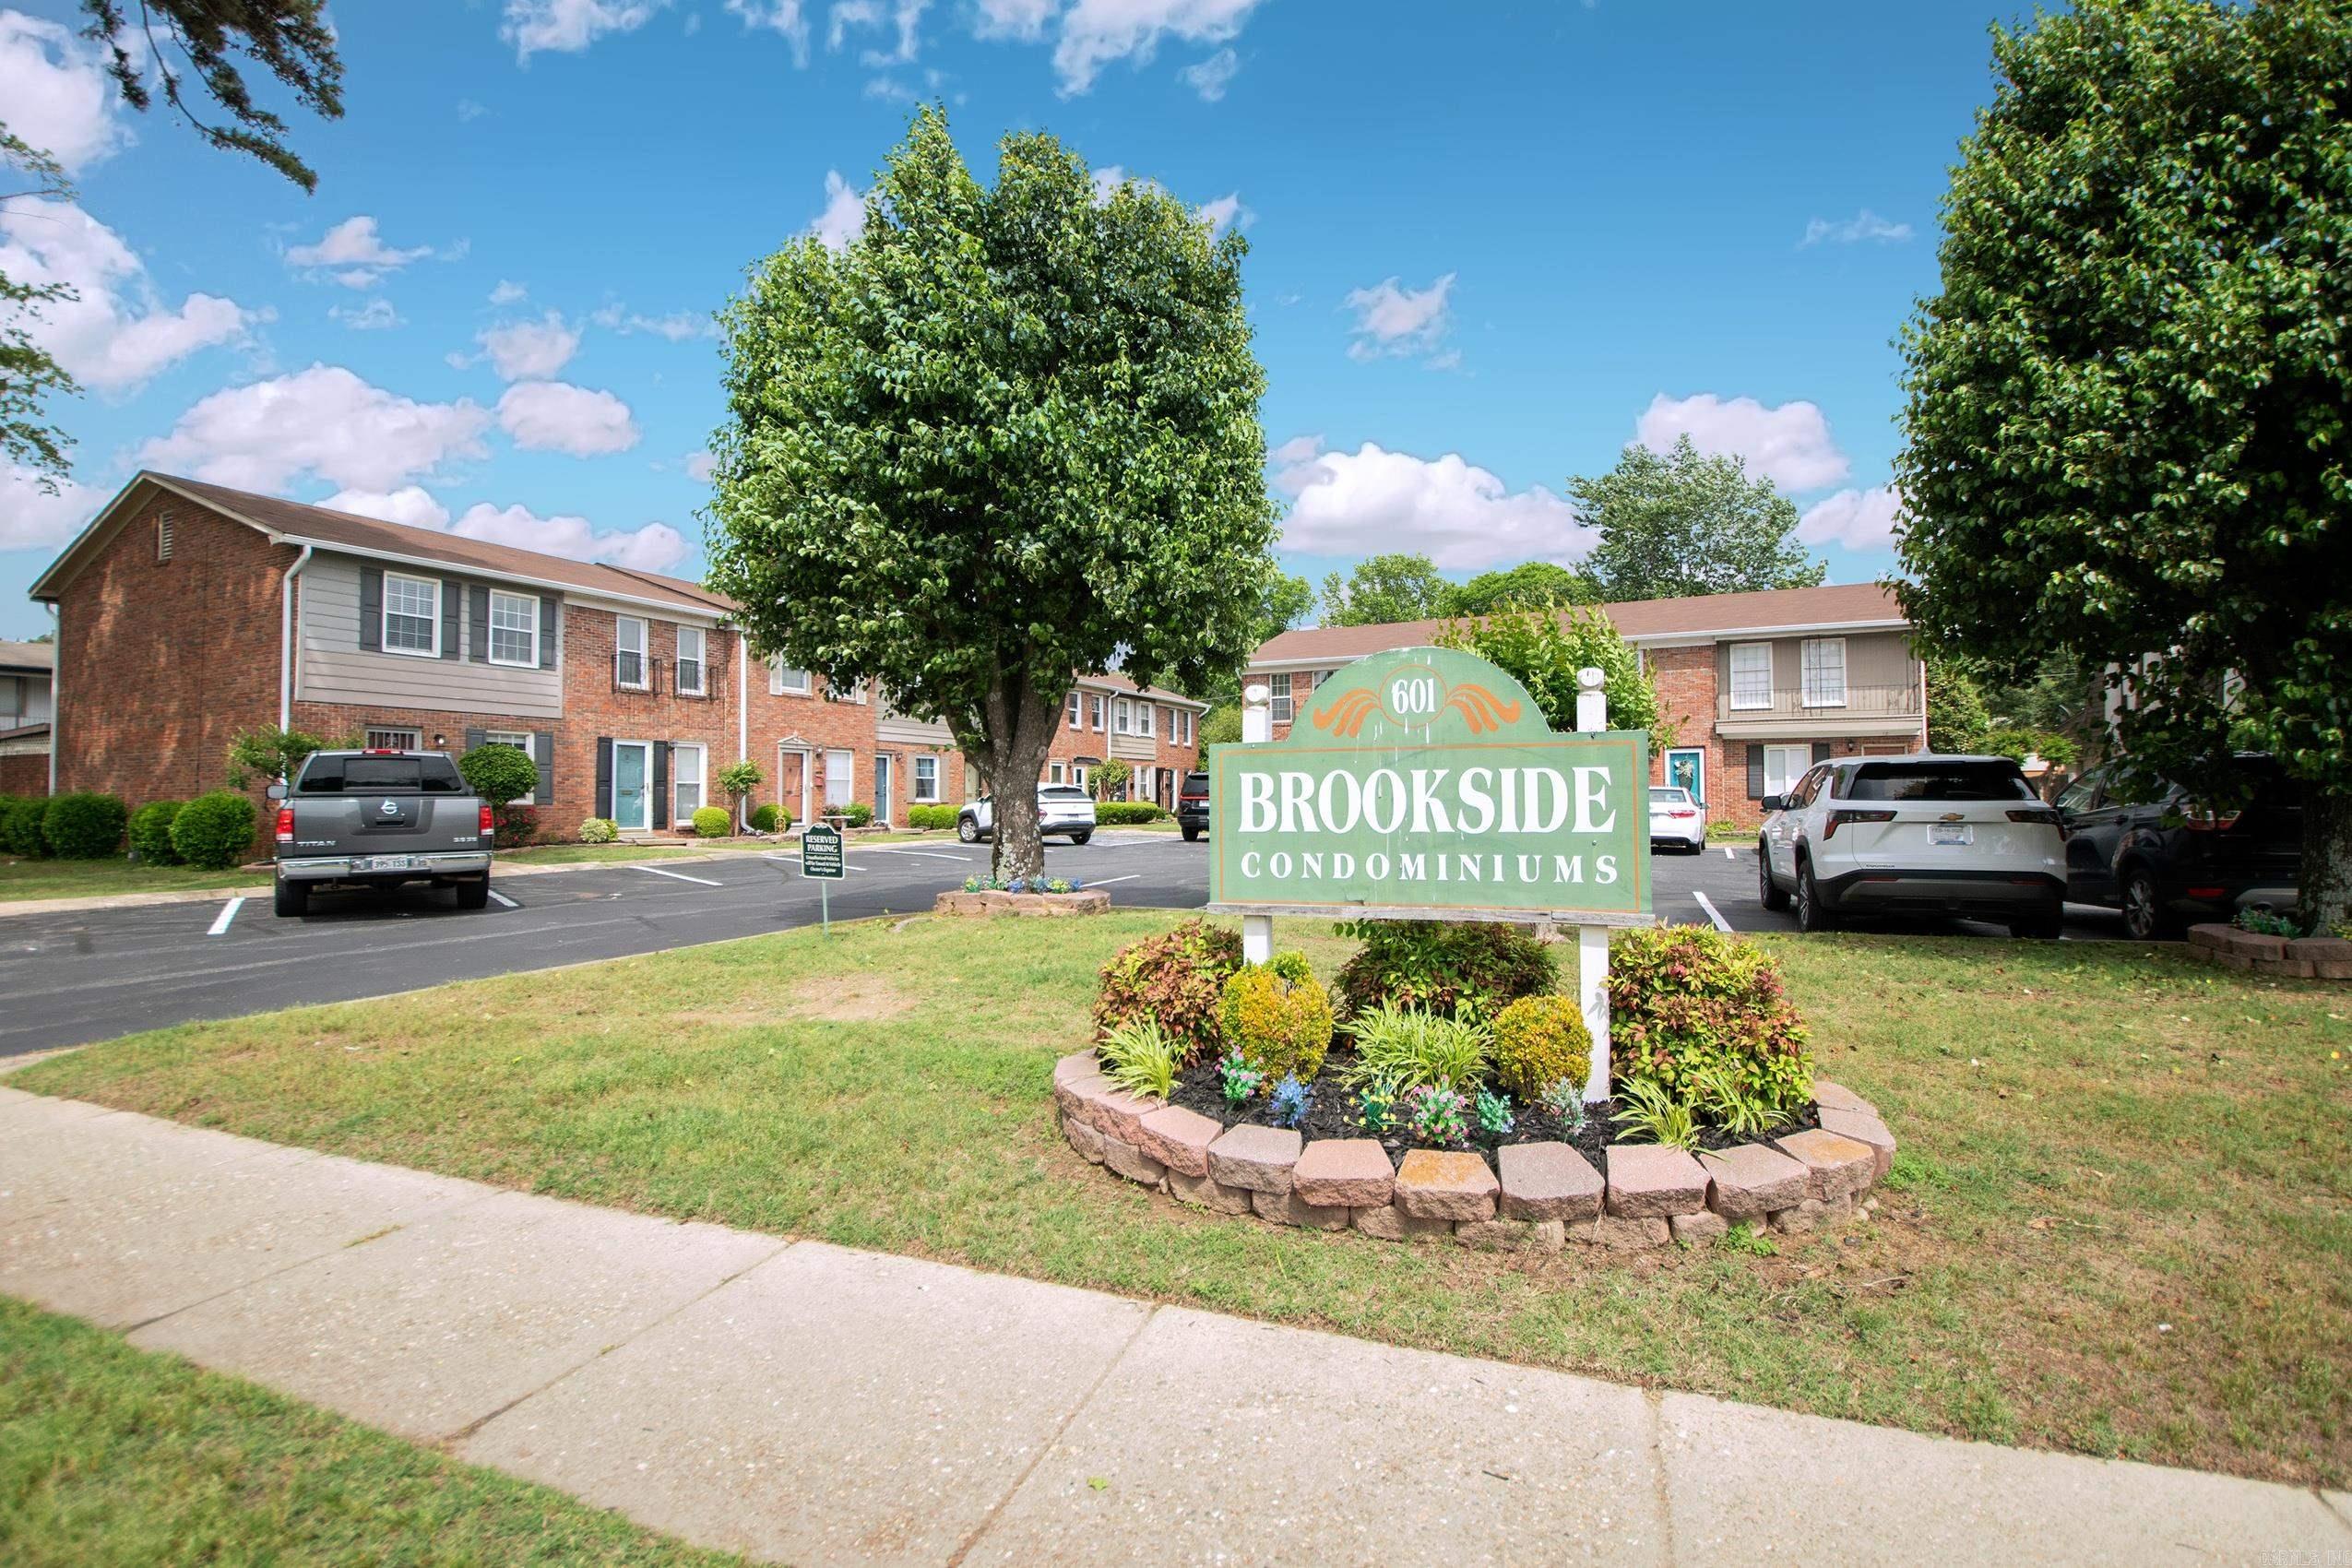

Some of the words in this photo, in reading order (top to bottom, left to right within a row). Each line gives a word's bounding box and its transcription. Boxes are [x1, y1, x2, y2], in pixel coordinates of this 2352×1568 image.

[1391, 677, 1436, 715] 601
[1238, 766, 1617, 835] BROOKSIDE
[805, 835, 838, 844] RESERVED
[807, 844, 837, 853] PARKING
[1241, 851, 1618, 885] CONDOMINIUMS
